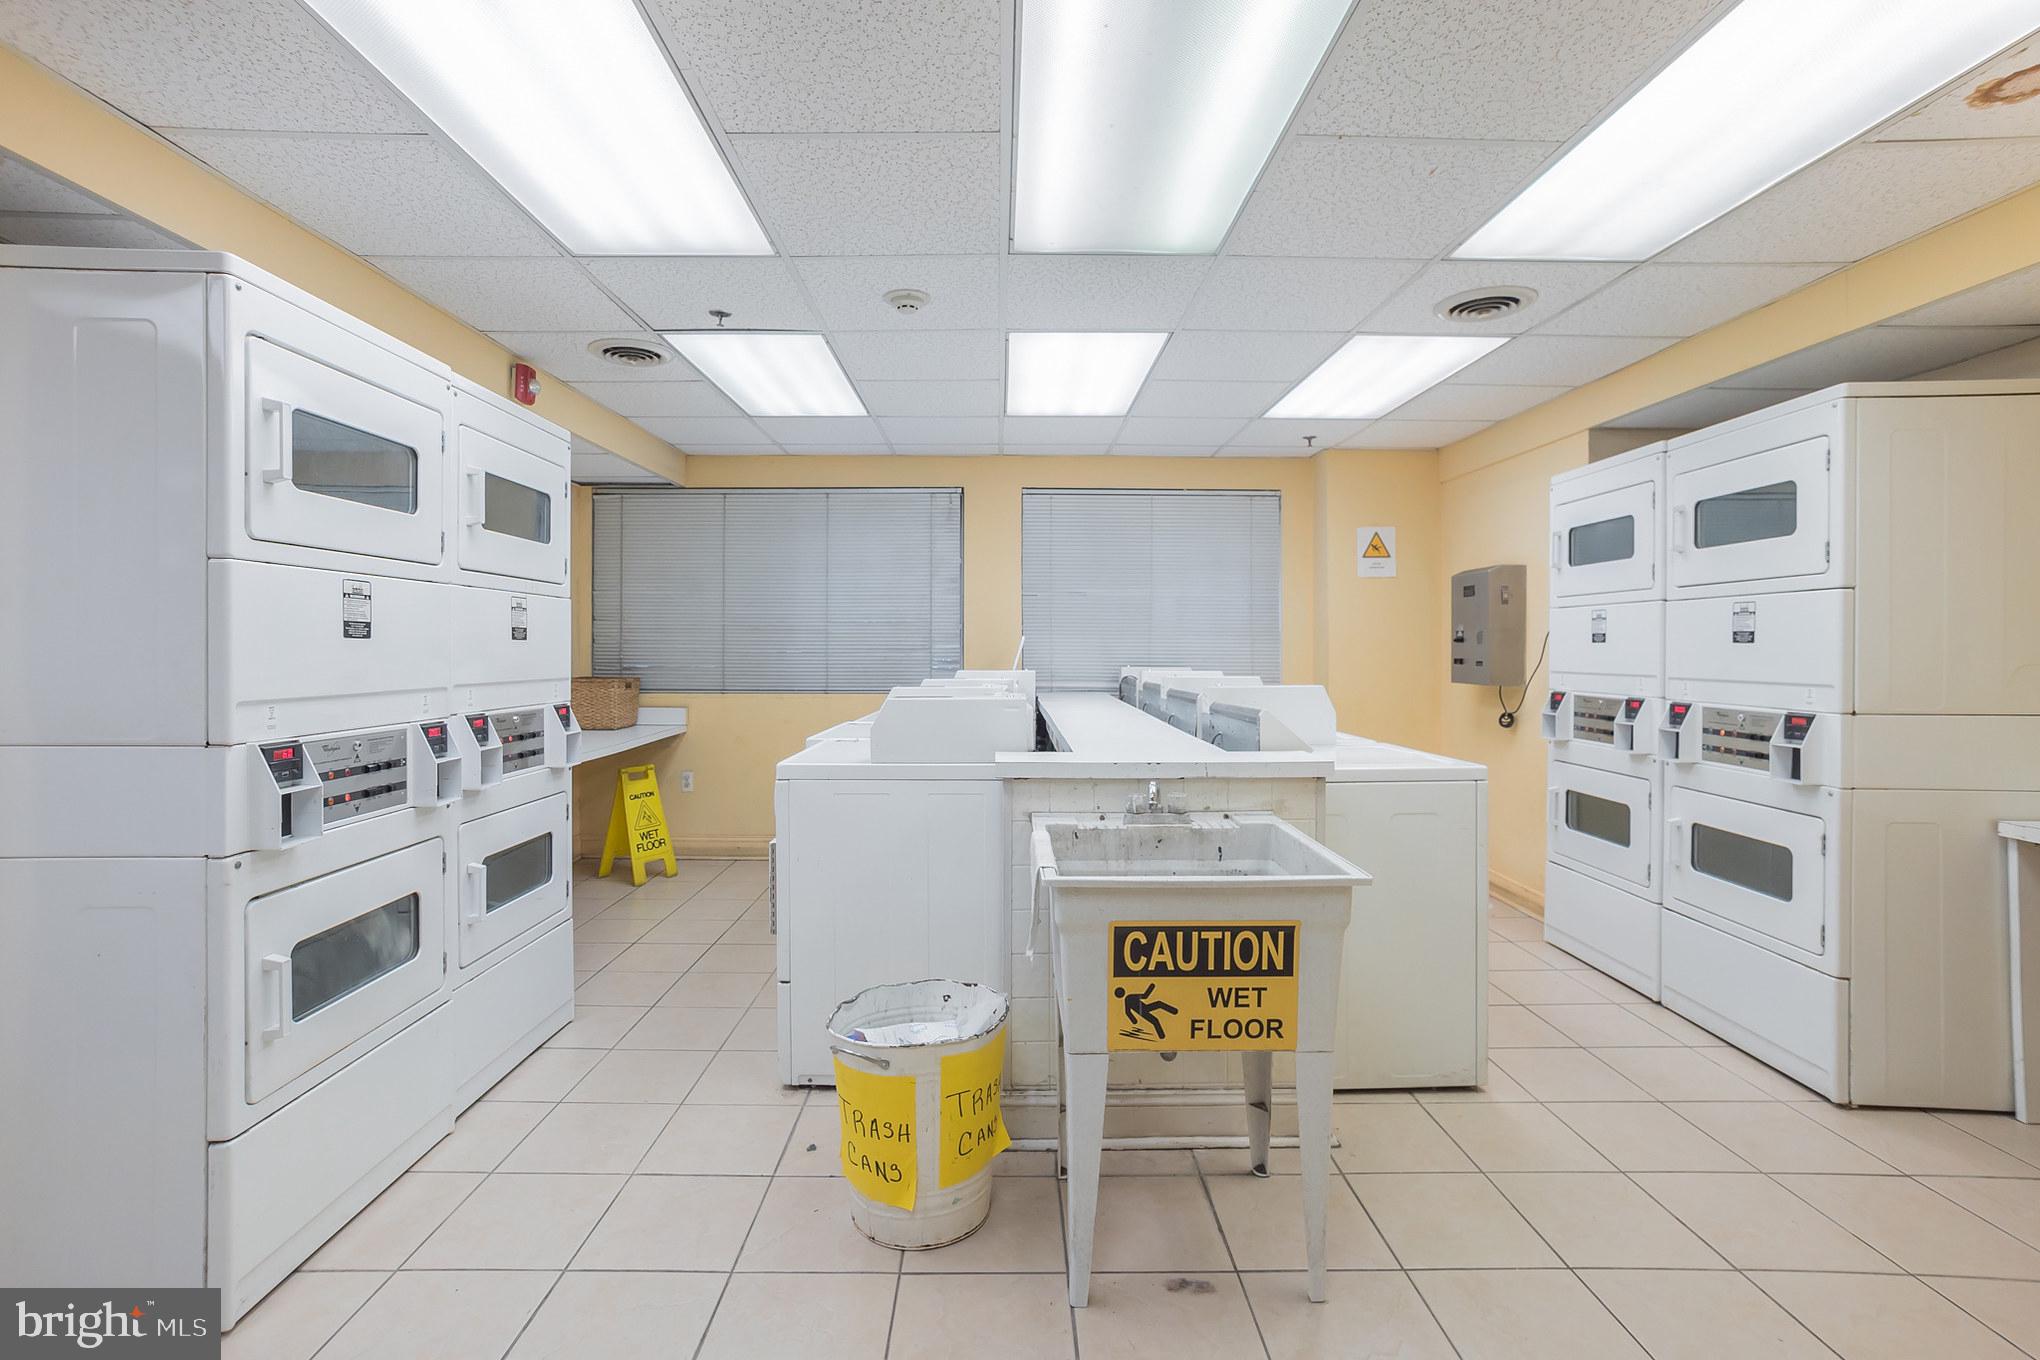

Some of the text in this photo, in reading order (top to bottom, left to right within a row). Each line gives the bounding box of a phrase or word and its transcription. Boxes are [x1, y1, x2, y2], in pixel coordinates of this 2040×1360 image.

[629, 791, 655, 801] CAUTION
[636, 838, 666, 853] FLOOR
[639, 829, 659, 841] WET
[1123, 930, 1285, 972] CAUTION
[1207, 987, 1268, 1008] WET
[1190, 1018, 1284, 1039] FLOOR
[838, 1093, 911, 1143] TRASH
[847, 1140, 903, 1184] CANS
